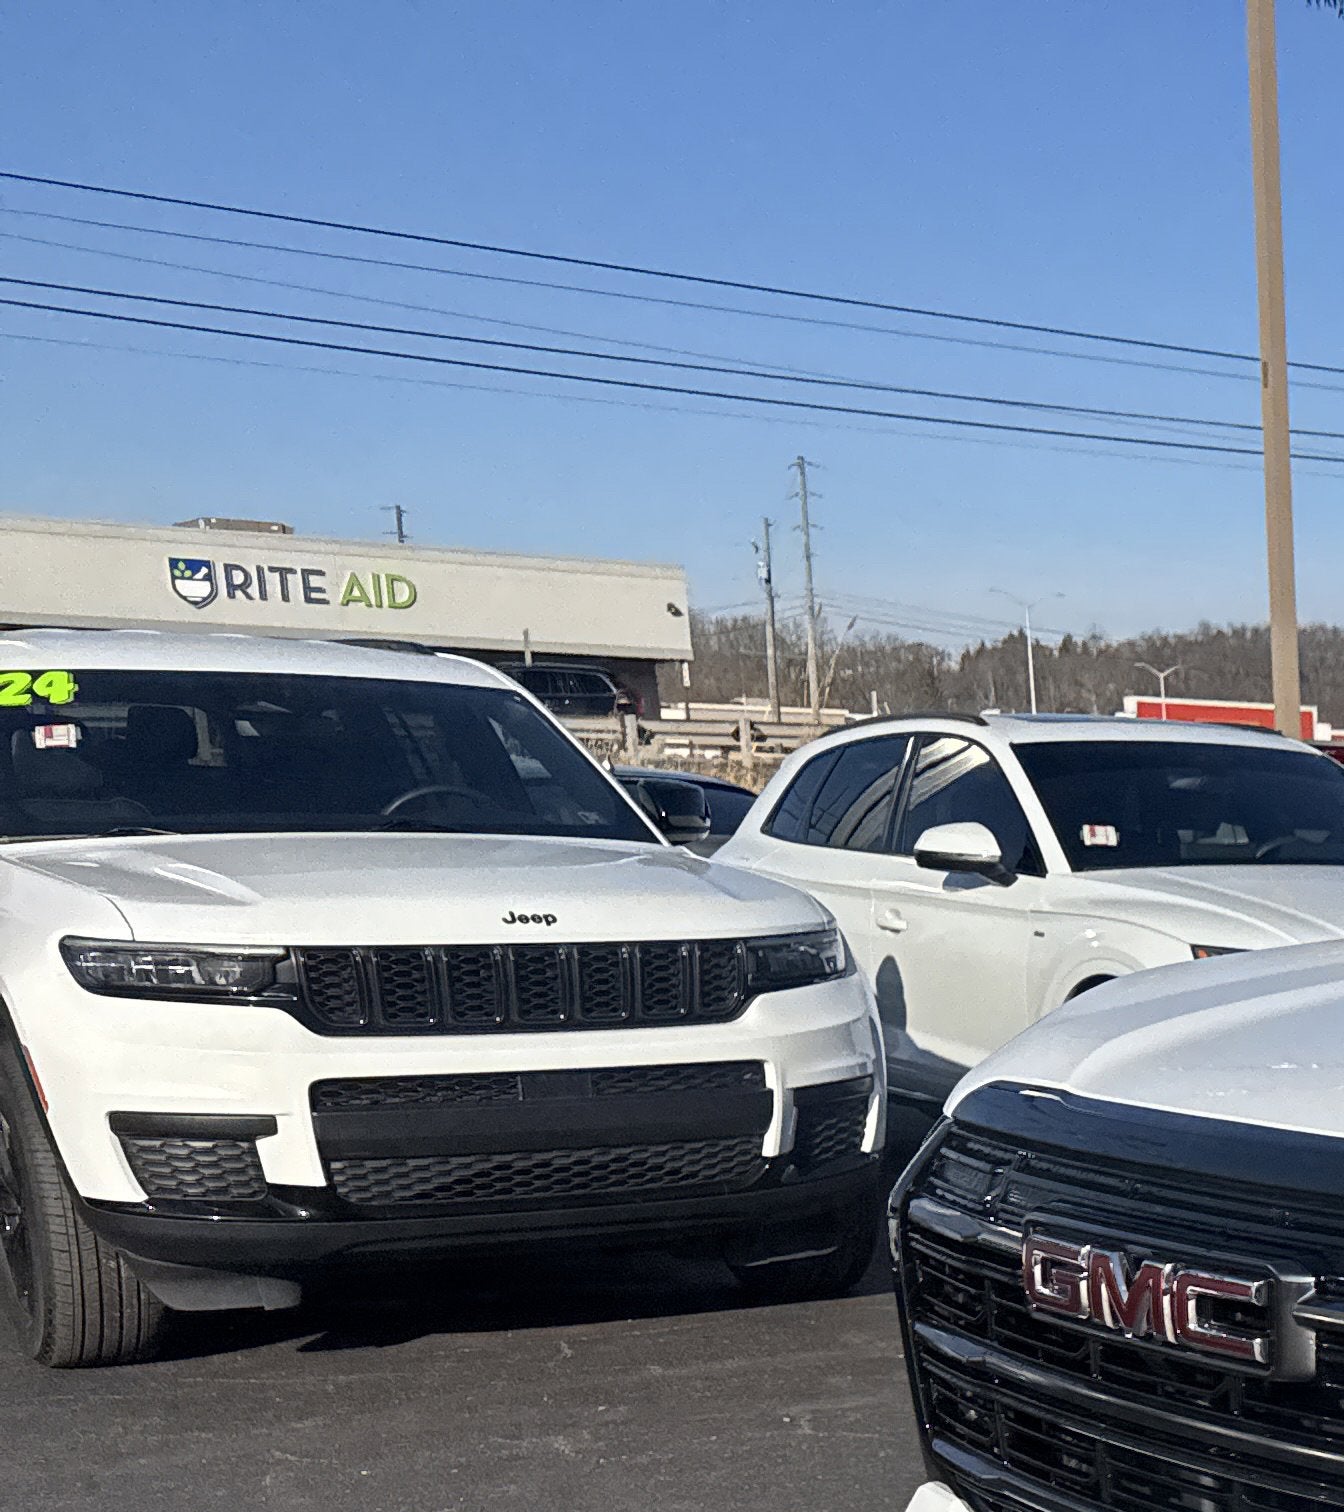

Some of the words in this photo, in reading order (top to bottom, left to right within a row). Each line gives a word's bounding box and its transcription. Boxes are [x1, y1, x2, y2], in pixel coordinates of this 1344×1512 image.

[222, 563, 331, 605] RITE
[340, 571, 418, 610] AID
[0, 670, 79, 706] 24
[501, 910, 558, 927] Jeep
[1023, 1232, 1271, 1365] GMC
